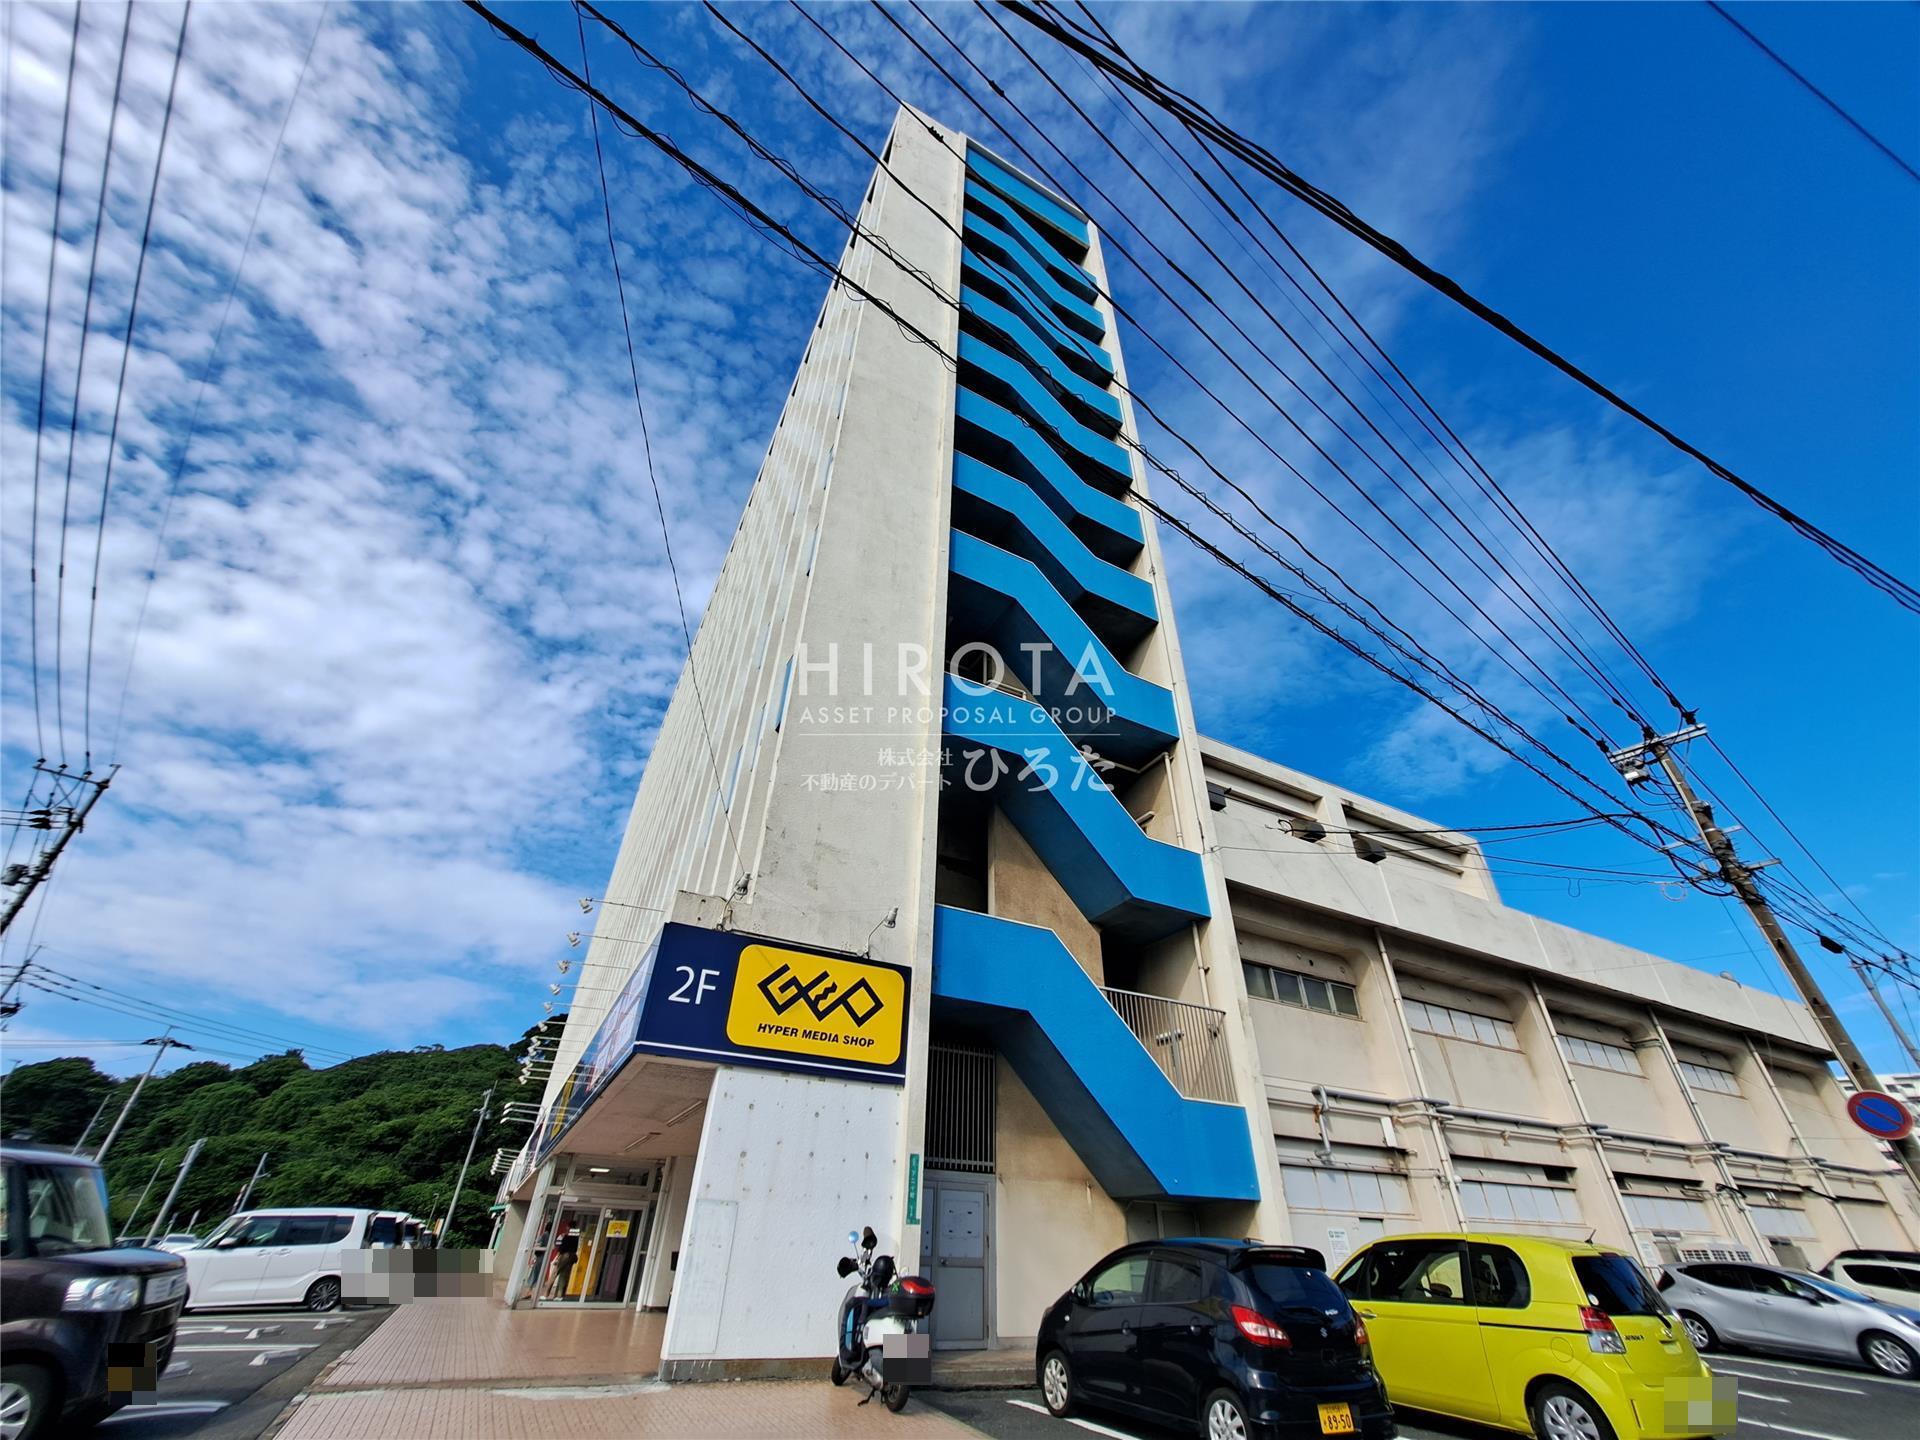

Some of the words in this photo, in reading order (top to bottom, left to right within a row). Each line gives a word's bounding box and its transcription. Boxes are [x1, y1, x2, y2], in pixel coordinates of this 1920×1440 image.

[668, 965, 720, 1005] 2F
[757, 963, 884, 1028] GEO
[757, 1023, 799, 1037] HYPER
[801, 1030, 840, 1044] MEDIA
[842, 1035, 875, 1048] SHOP
